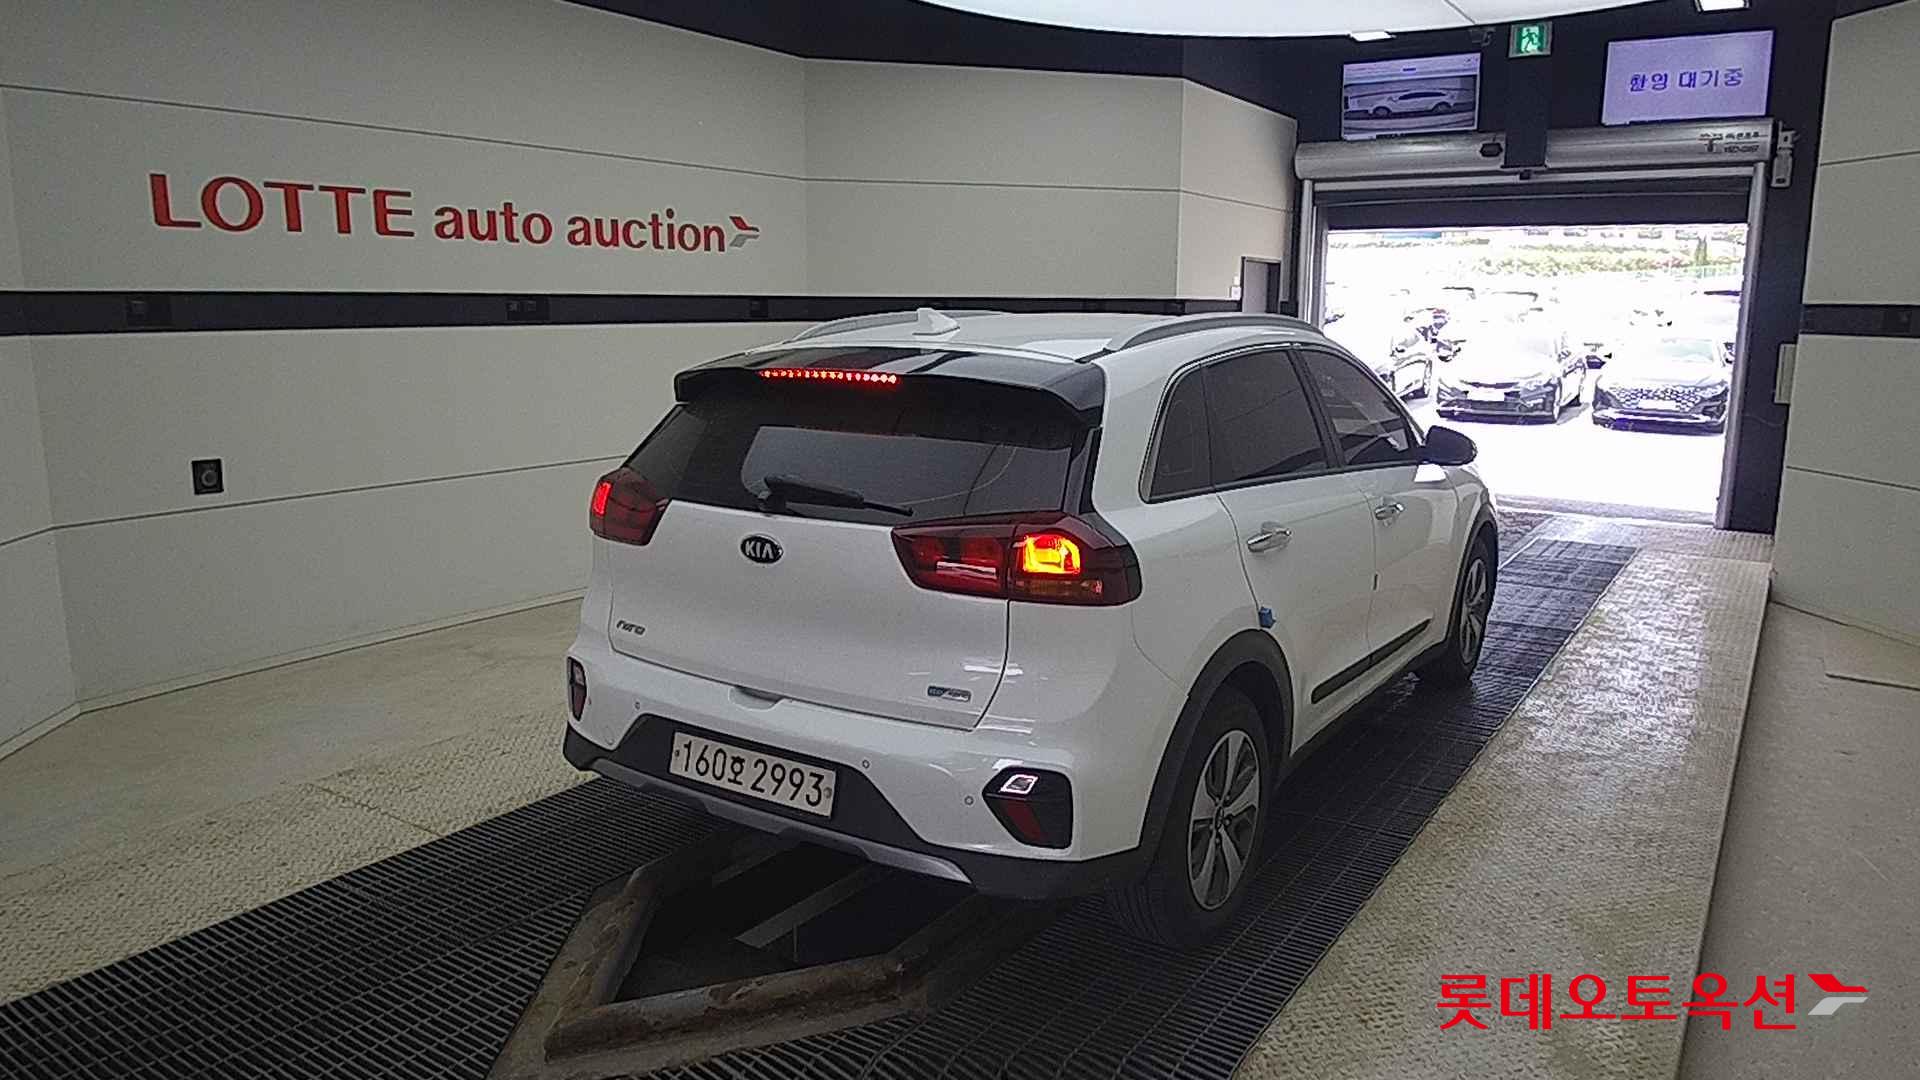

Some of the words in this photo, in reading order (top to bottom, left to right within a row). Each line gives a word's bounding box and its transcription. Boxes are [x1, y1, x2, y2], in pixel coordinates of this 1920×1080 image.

[1678, 68, 1744, 89] 대기중
[149, 173, 416, 238] LOTTE
[433, 202, 553, 245] auto
[566, 208, 727, 253] auction
[745, 540, 775, 560] KIA
